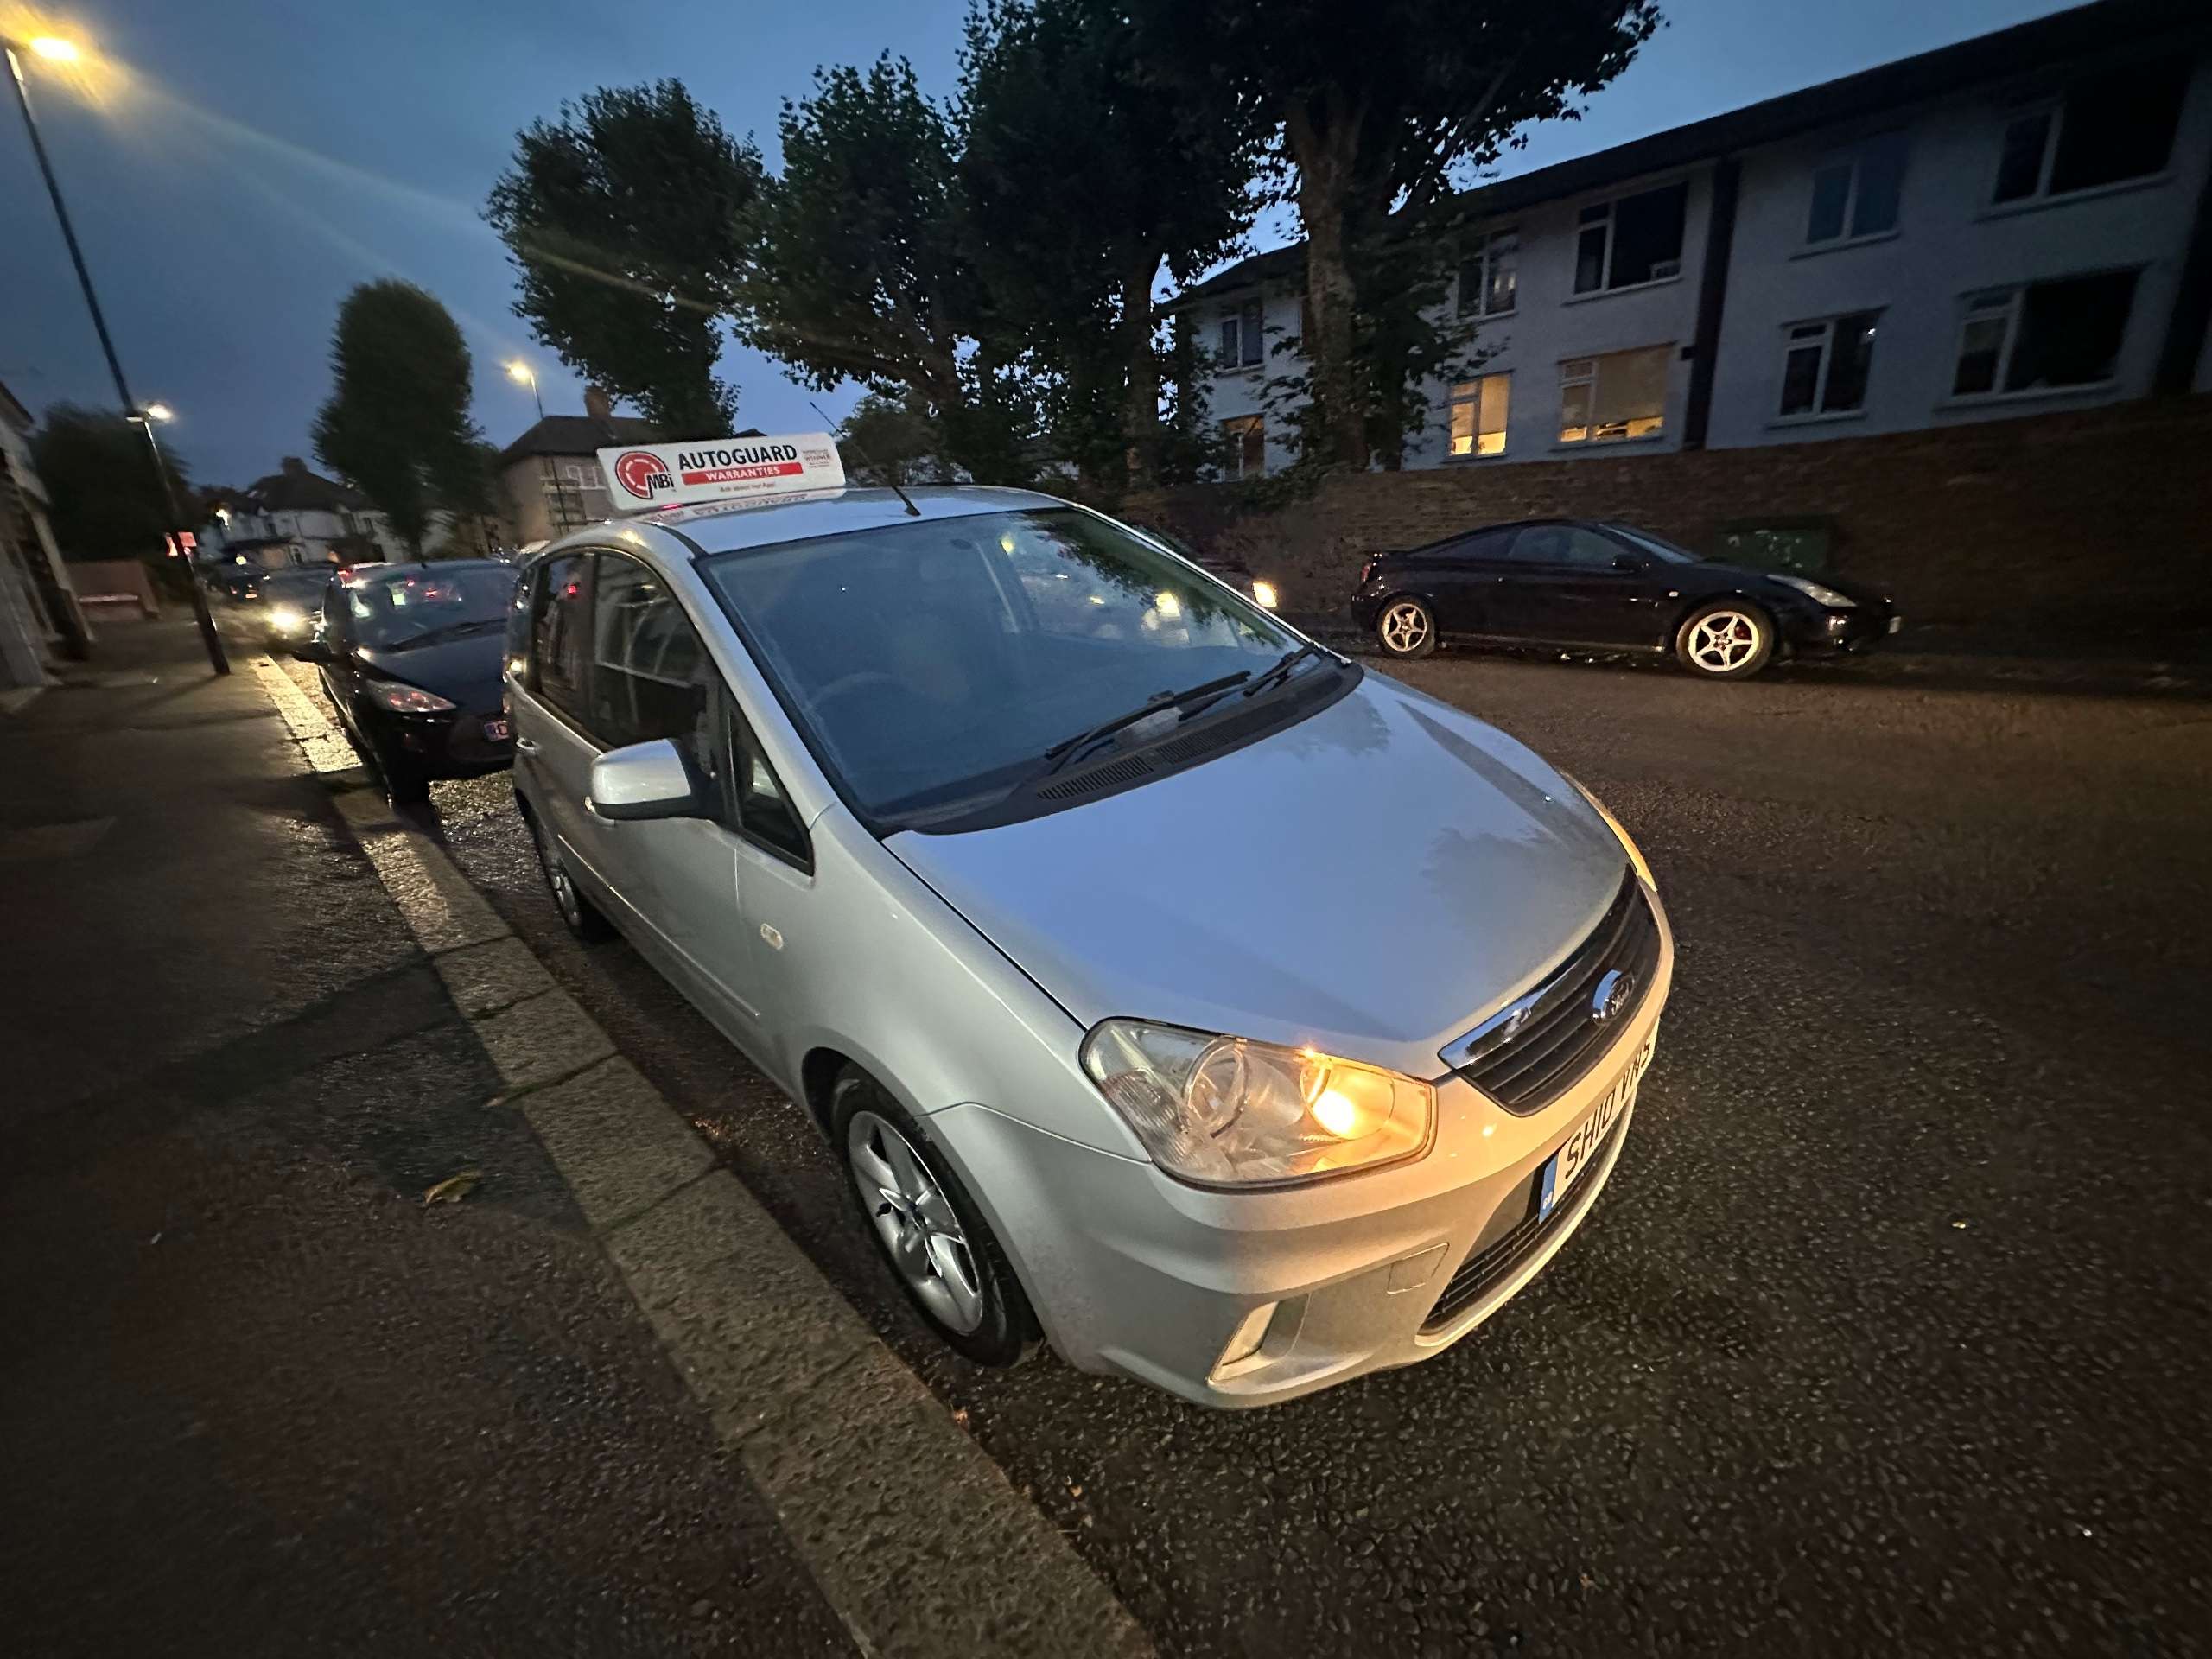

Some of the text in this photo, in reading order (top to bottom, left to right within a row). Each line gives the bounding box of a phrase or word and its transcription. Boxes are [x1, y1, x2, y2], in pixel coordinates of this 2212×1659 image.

[678, 444, 797, 470] AUTOGUARD
[705, 466, 781, 481] WARRANTIES
[1565, 1086, 1617, 1179] SH10
